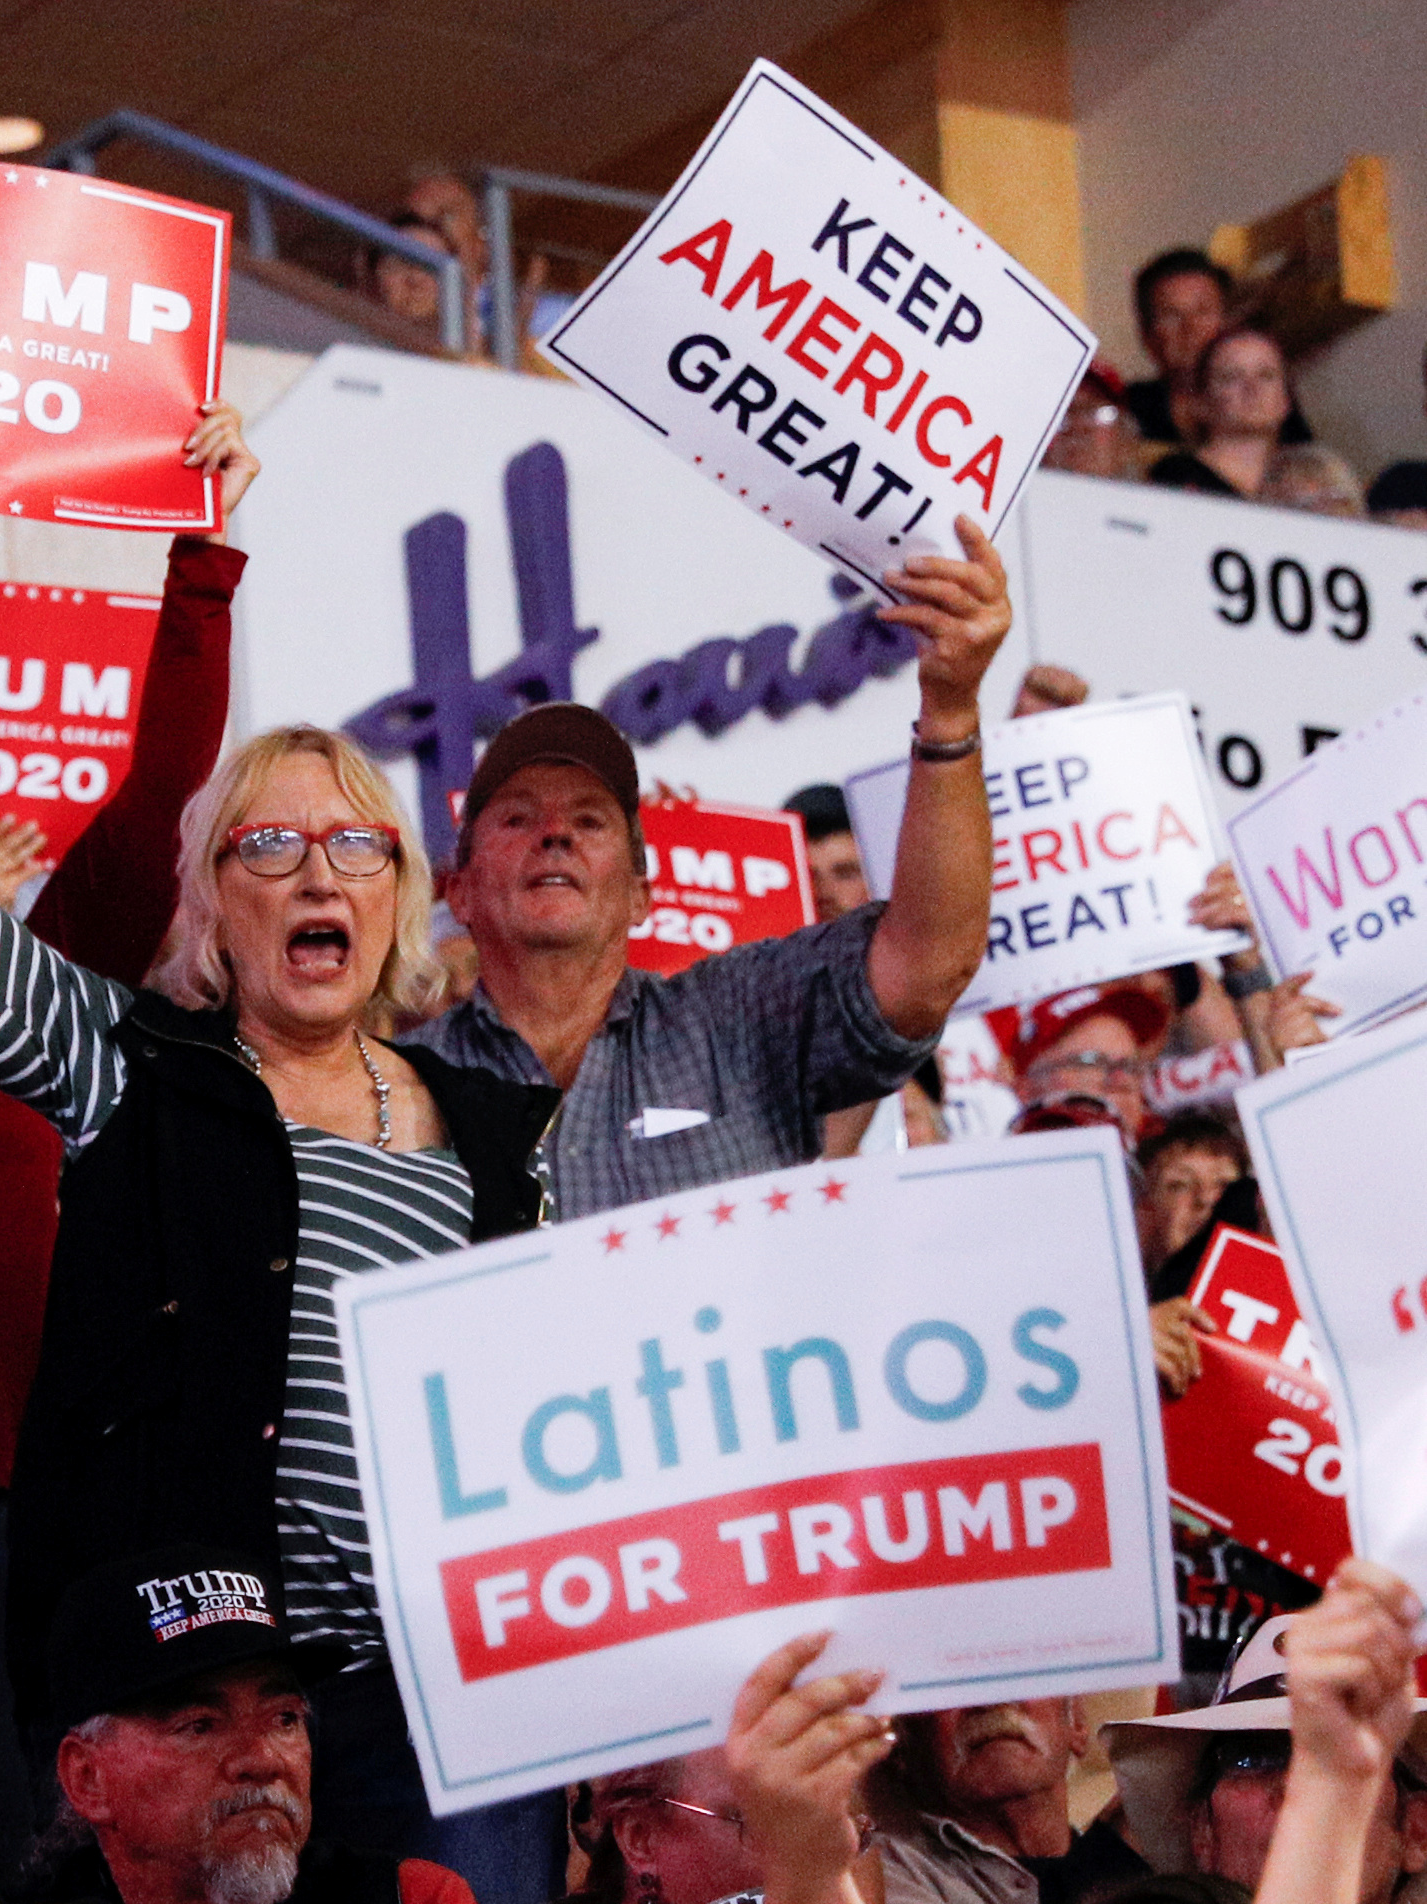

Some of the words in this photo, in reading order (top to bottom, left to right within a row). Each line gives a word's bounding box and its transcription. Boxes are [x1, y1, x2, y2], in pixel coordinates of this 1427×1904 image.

[811, 198, 983, 348] KEEP
[22, 338, 110, 373] GREAT!
[657, 218, 1005, 513] AMERICA
[667, 333, 933, 546] GREAT!
[1210, 548, 1370, 643] 909
[984, 756, 1090, 818] EEP
[993, 802, 1199, 892] ERICA
[985, 877, 1163, 962] REAT!
[1328, 895, 1416, 957] FOR
[422, 1304, 1081, 1523] Latinos
[1253, 1416, 1349, 1498] 20
[136, 1570, 267, 1616] Trump
[197, 1594, 246, 1612] 2020
[473, 1536, 688, 1649] FOR
[718, 1475, 1079, 1588] TRUMP
[159, 1618, 190, 1641] KEEP
[190, 1608, 244, 1630] AMERICA
